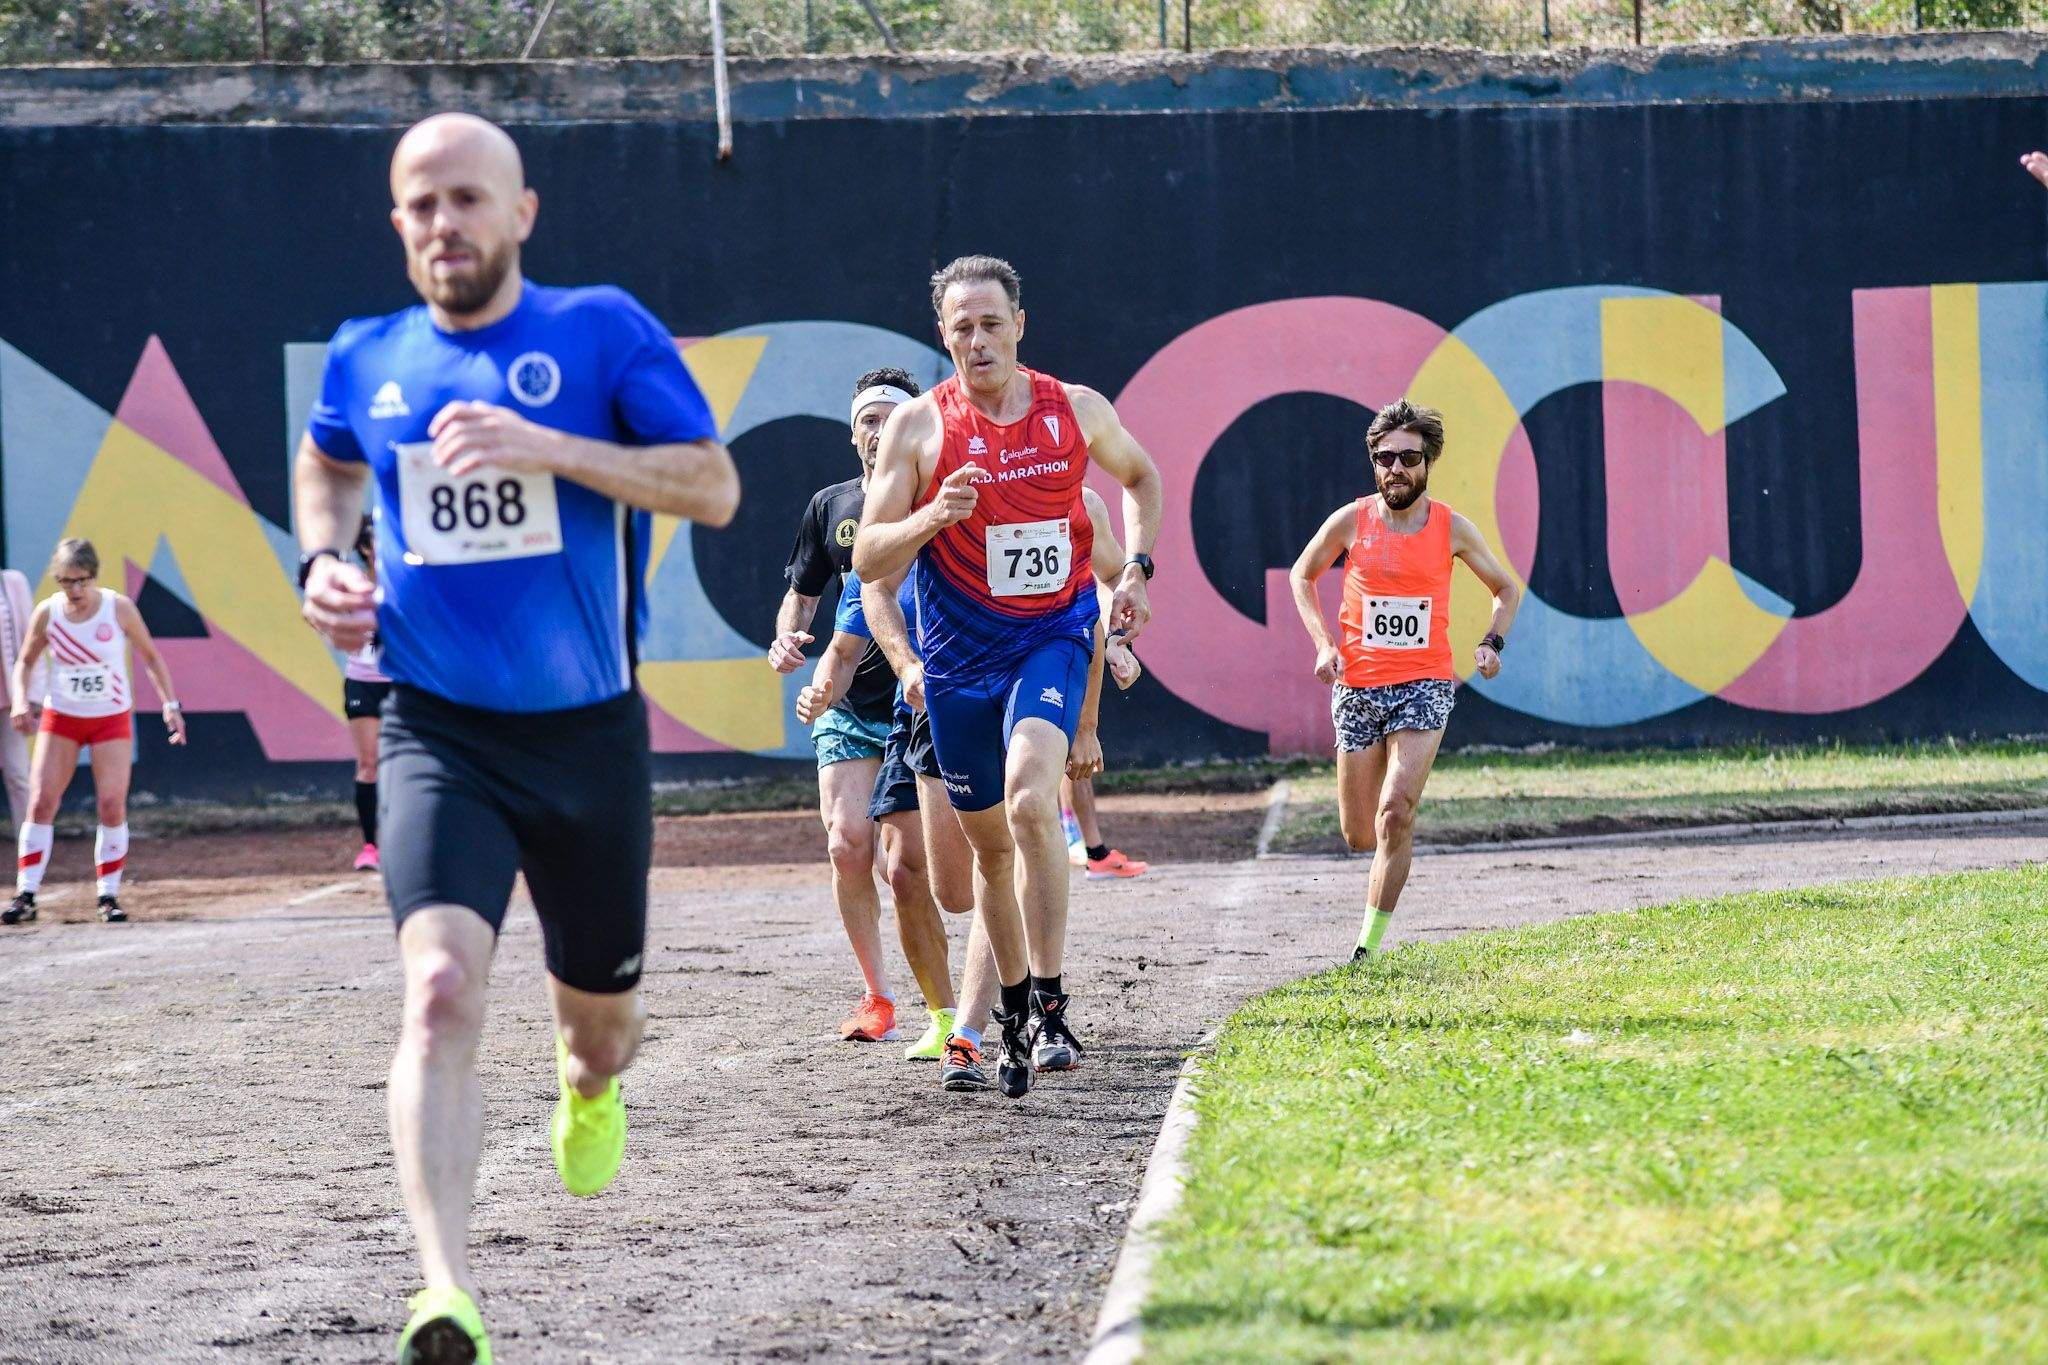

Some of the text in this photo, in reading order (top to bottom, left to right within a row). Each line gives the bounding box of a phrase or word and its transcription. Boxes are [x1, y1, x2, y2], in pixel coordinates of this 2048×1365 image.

[998, 460, 1070, 483] MARATHON
[431, 478, 526, 533] 868
[1003, 545, 1060, 579] 736
[1374, 613, 1419, 637] 690
[70, 674, 105, 693] 765
